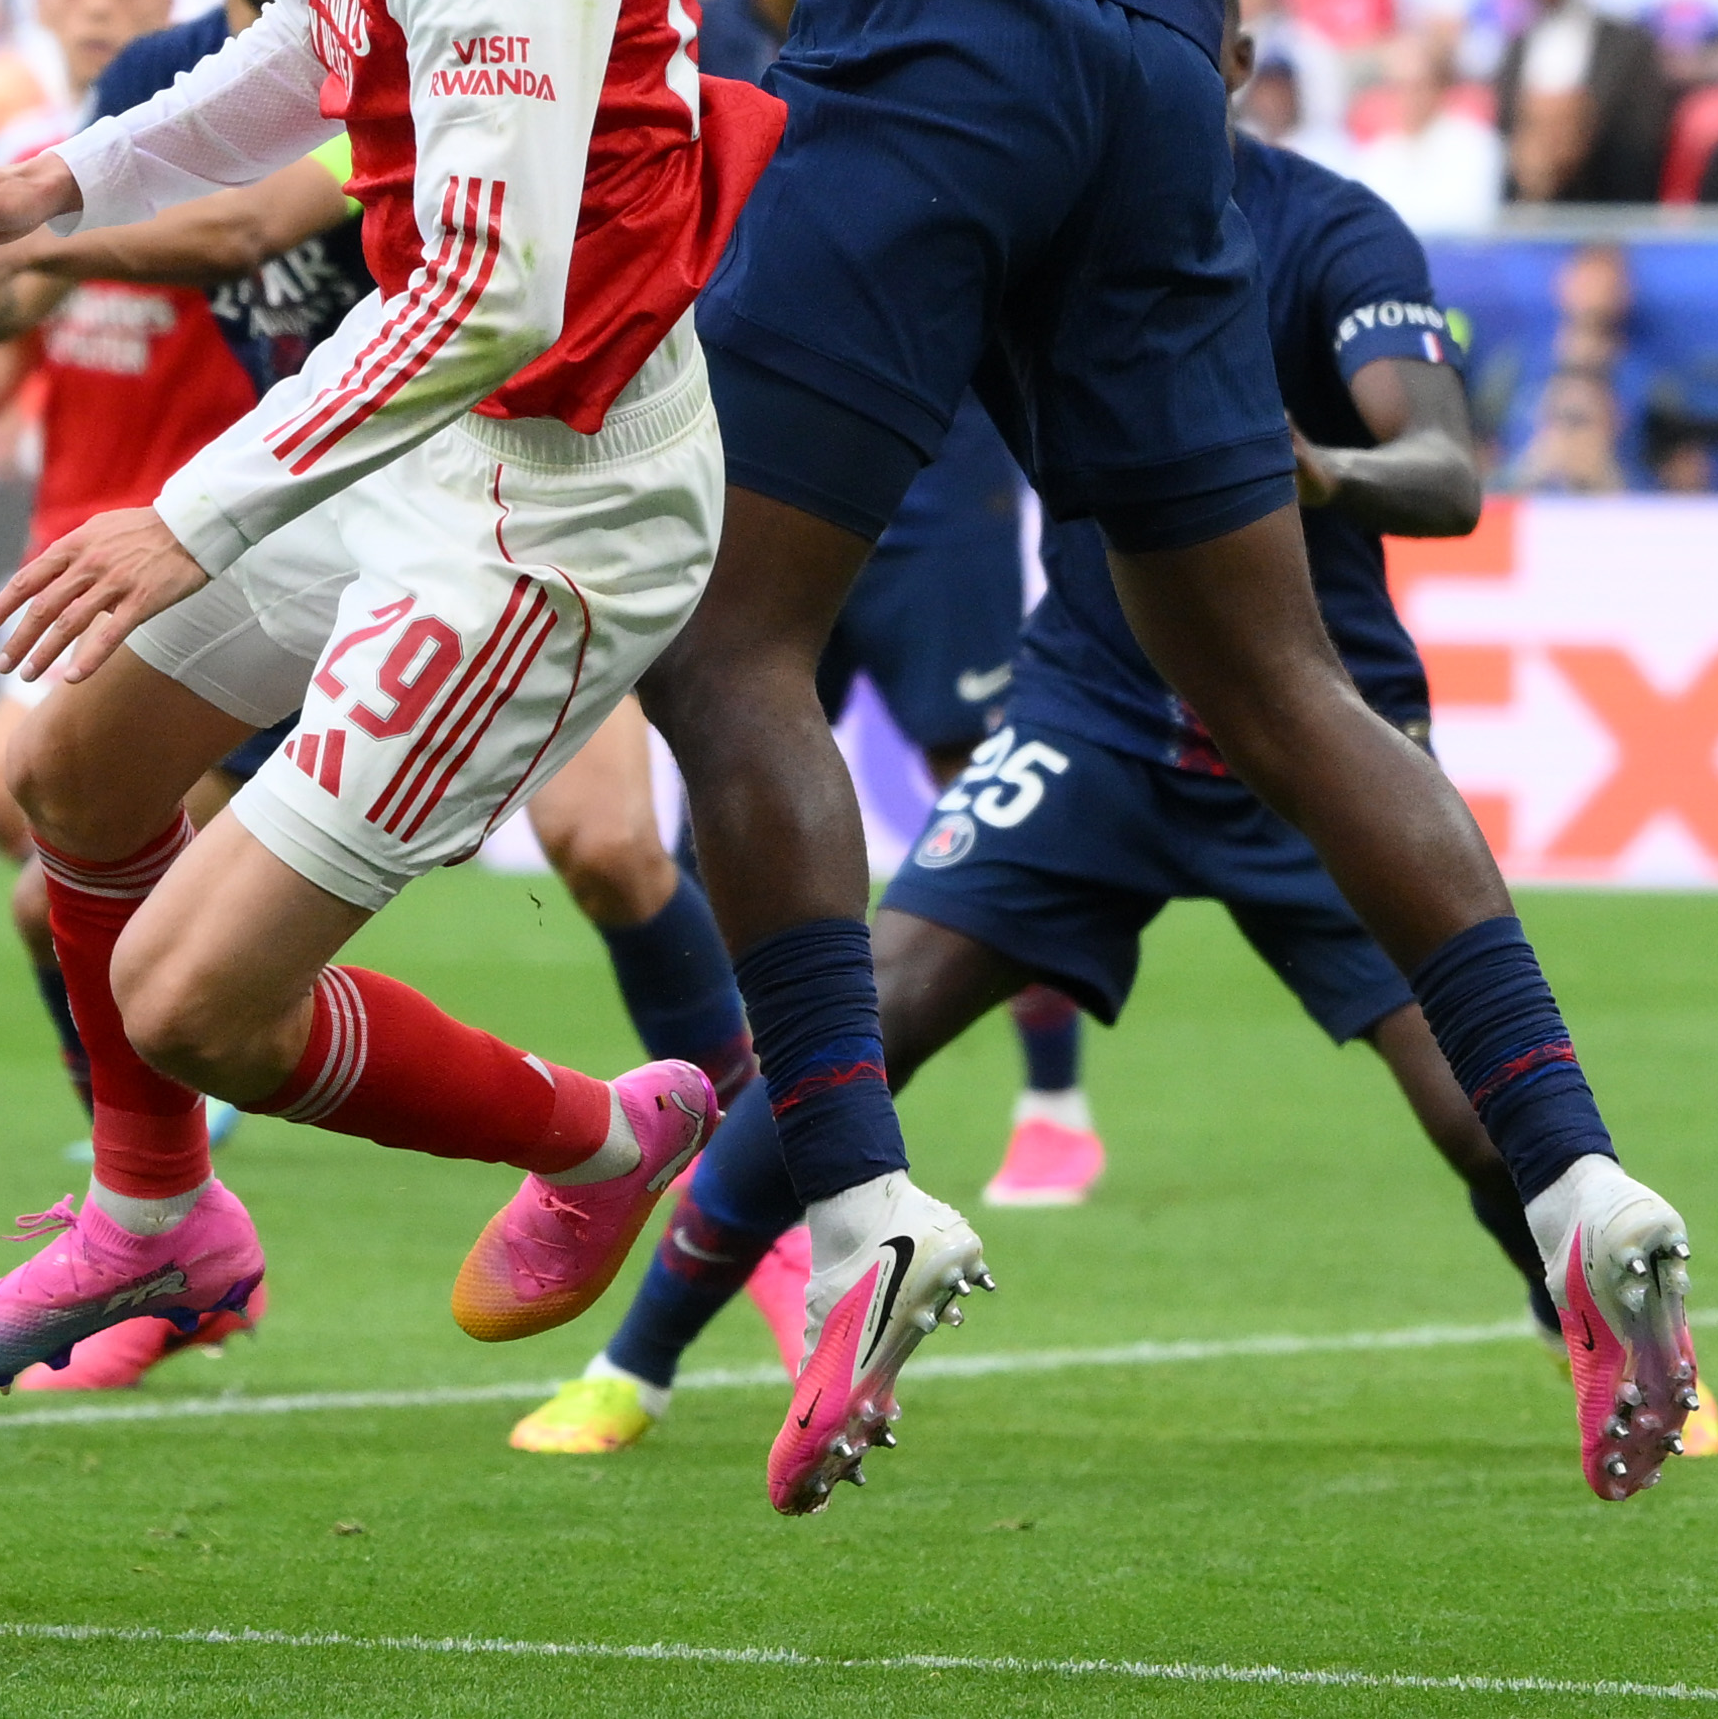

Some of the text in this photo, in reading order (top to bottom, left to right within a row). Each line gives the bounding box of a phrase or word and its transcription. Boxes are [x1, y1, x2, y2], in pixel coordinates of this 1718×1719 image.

[452, 35, 531, 65] VISIT
[429, 68, 557, 102] RWANDA
[1334, 300, 1444, 352] EYOND
[313, 593, 465, 743] 29
[935, 725, 1070, 829] 25
